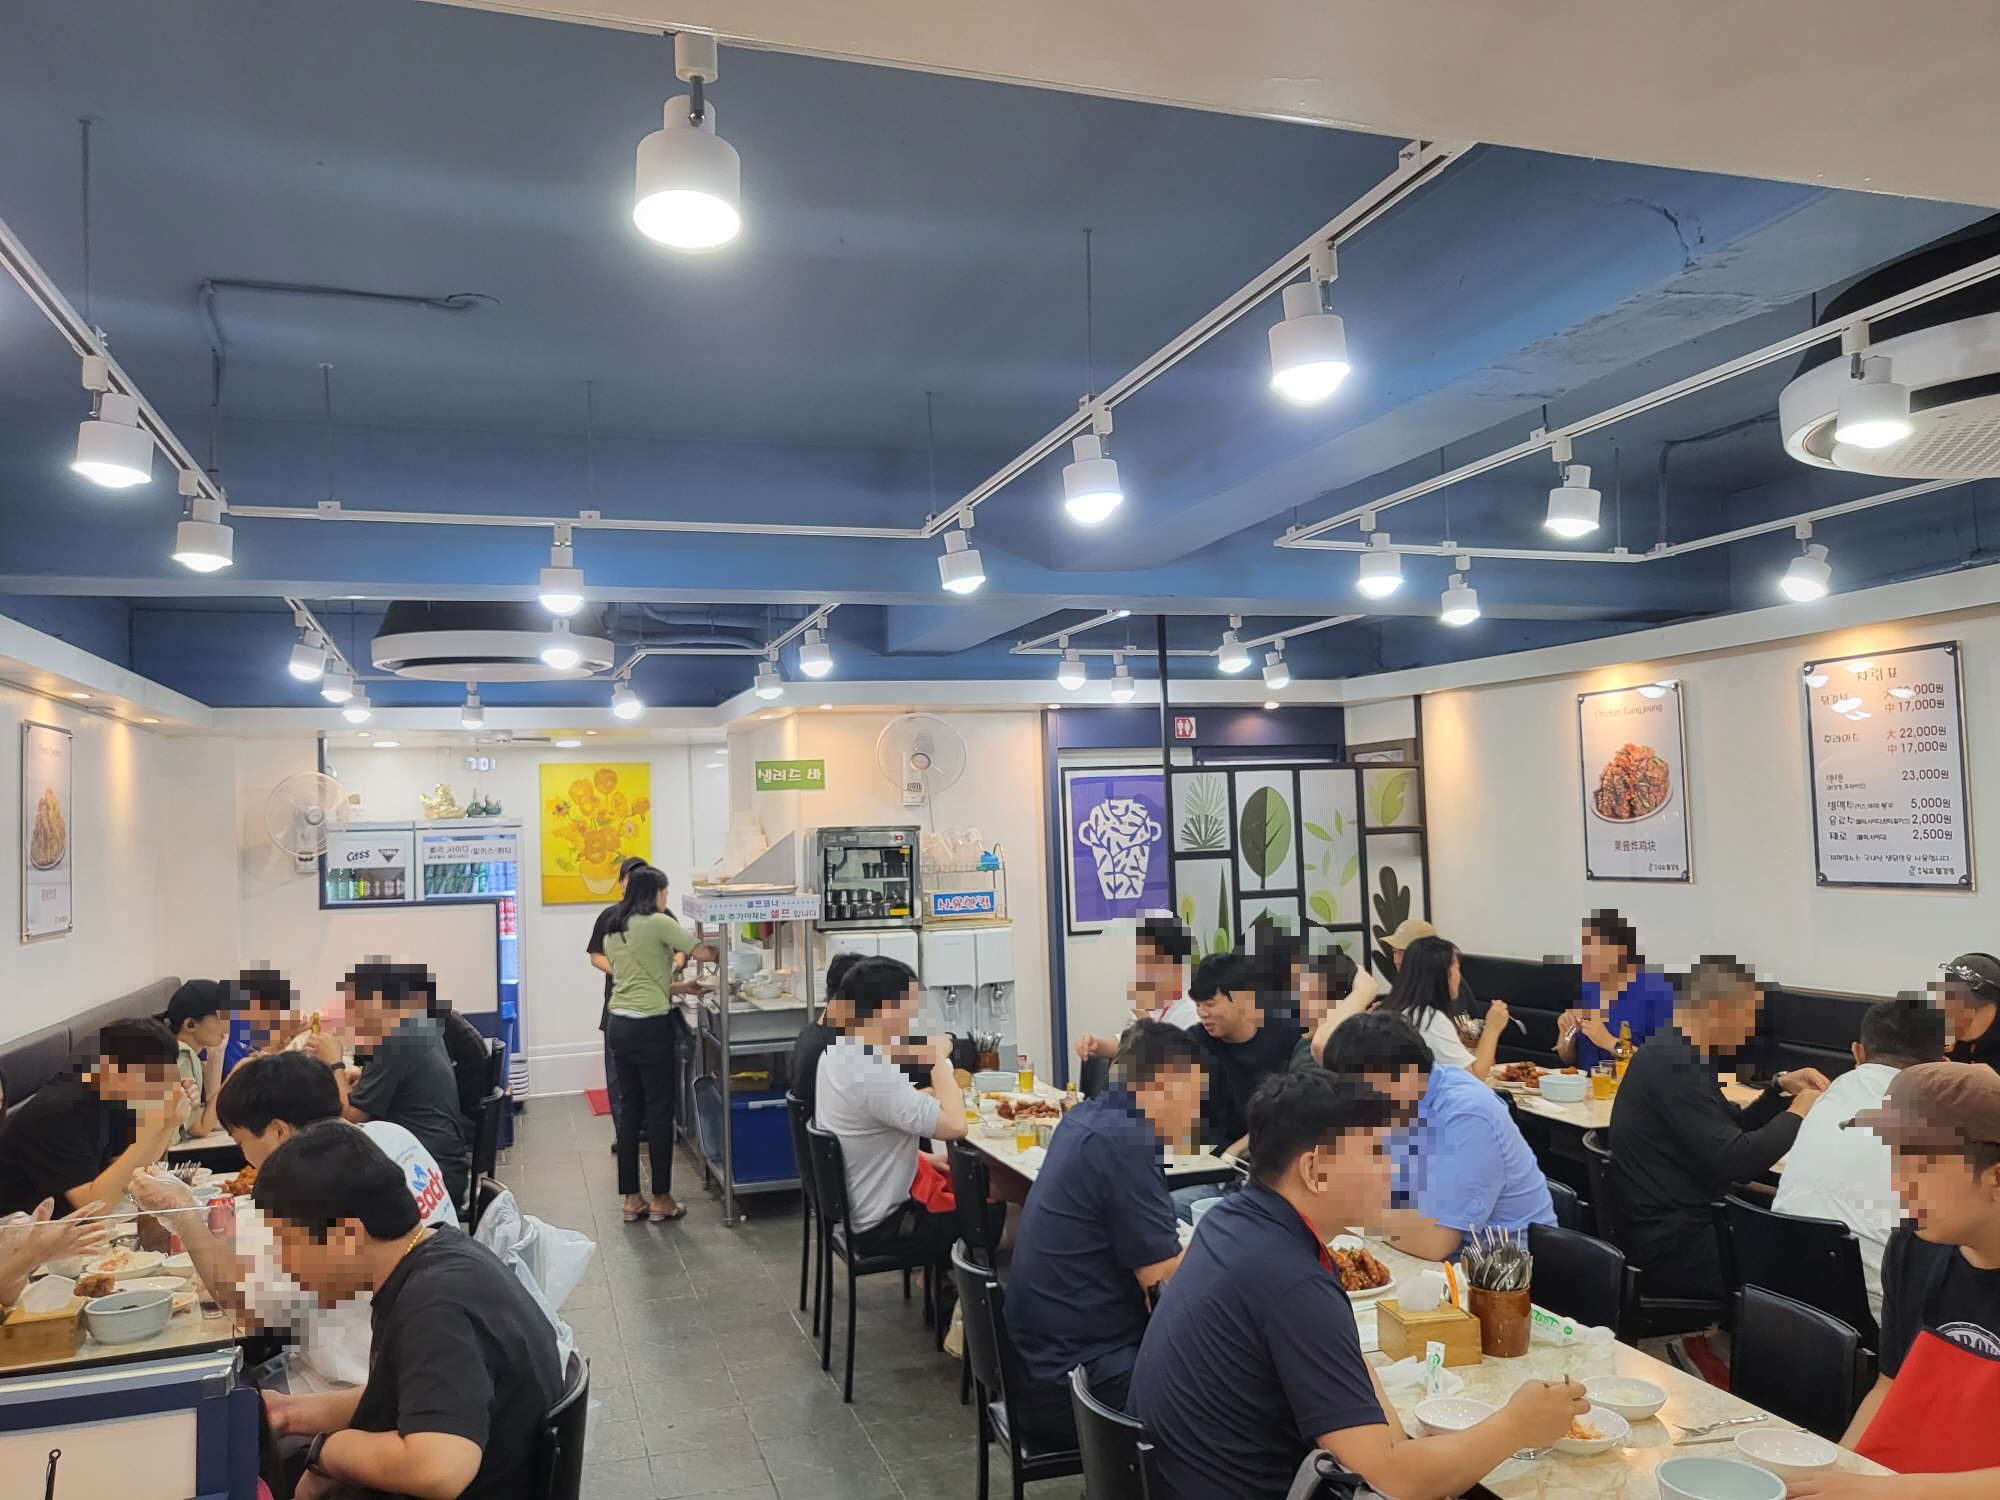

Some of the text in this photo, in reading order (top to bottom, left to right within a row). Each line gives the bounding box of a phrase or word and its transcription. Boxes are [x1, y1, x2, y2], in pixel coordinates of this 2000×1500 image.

[1885, 699, 1945, 713] 中 17,000원
[1595, 708, 1622, 719] Chicken
[1886, 729, 1896, 740] 大
[1899, 726, 1947, 739] 22,000원
[1888, 741, 1948, 755] 中 17,000원
[806, 768, 823, 781] 바
[1902, 769, 1949, 781] 23,000원
[1910, 798, 1951, 810] 5,000원
[1911, 813, 1952, 825] 2,000원
[1912, 829, 1953, 841] 2,500원
[746, 899, 779, 908] 셀프코너
[770, 908, 791, 918] 셀프
